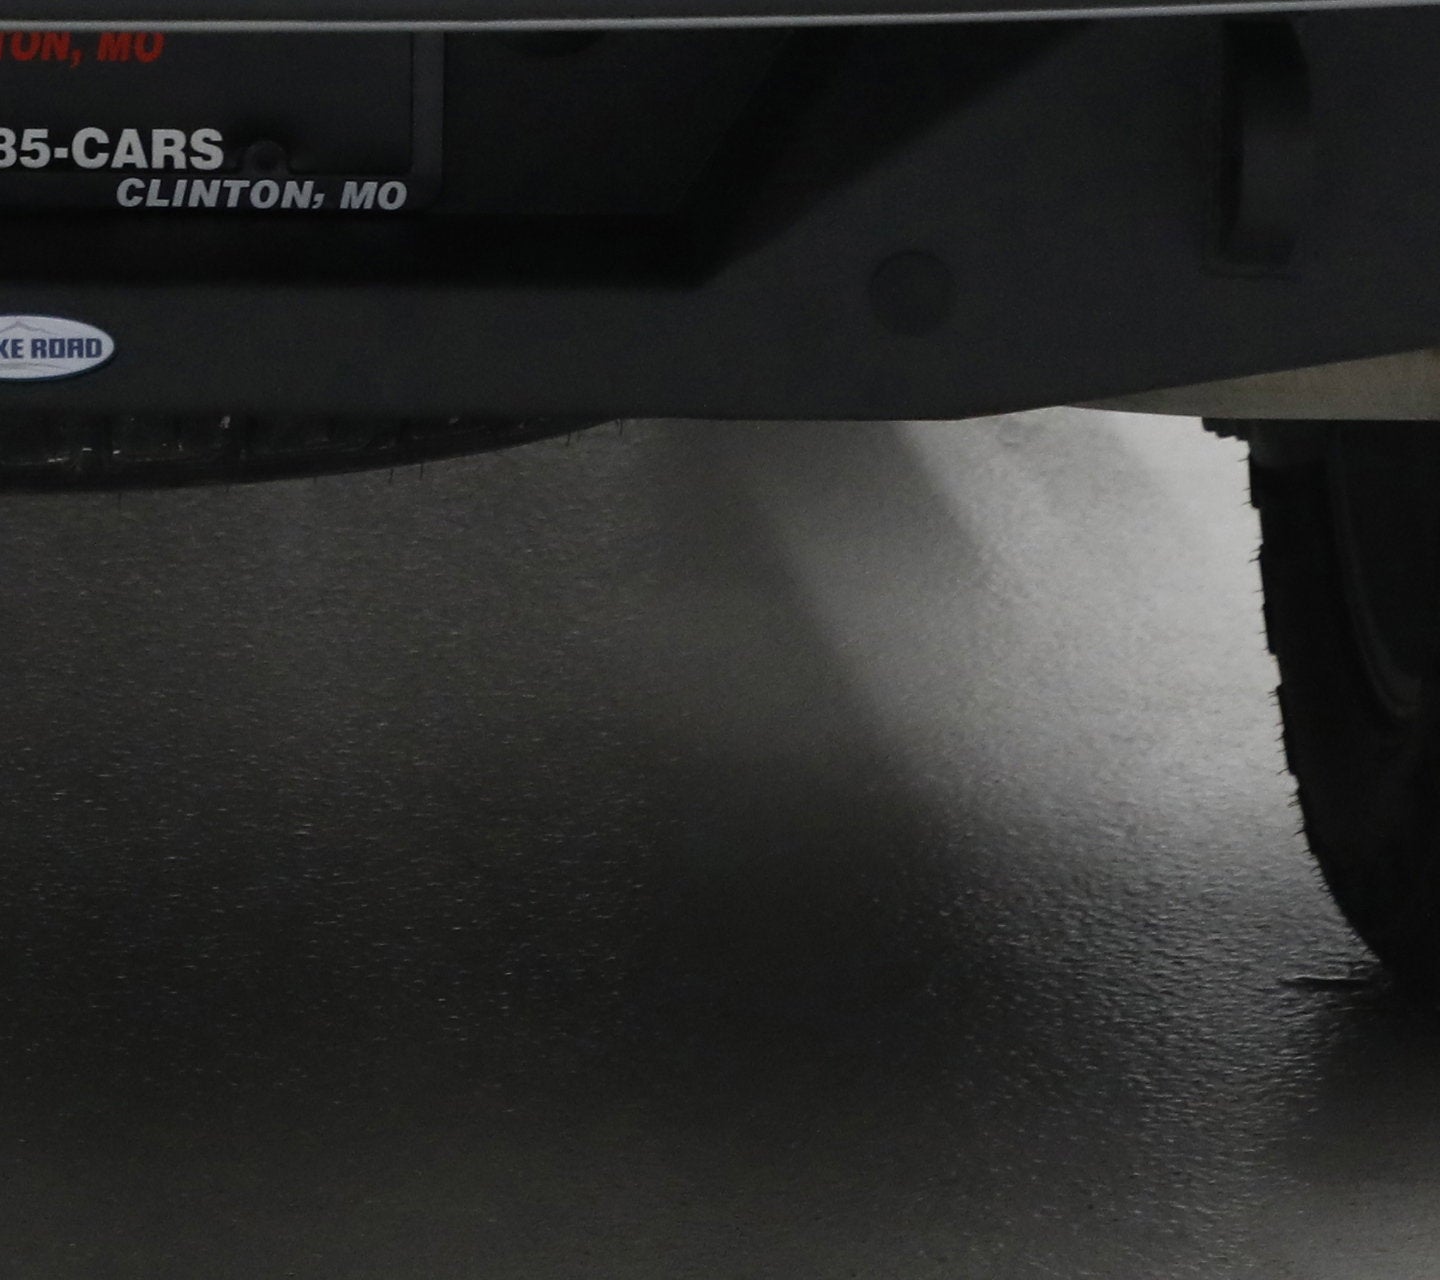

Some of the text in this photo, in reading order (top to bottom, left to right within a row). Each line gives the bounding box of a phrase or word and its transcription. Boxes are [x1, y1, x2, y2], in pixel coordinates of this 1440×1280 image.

[96, 30, 165, 63] MO
[116, 177, 407, 210] CLINTON, MO
[31, 338, 102, 358] ROAD
